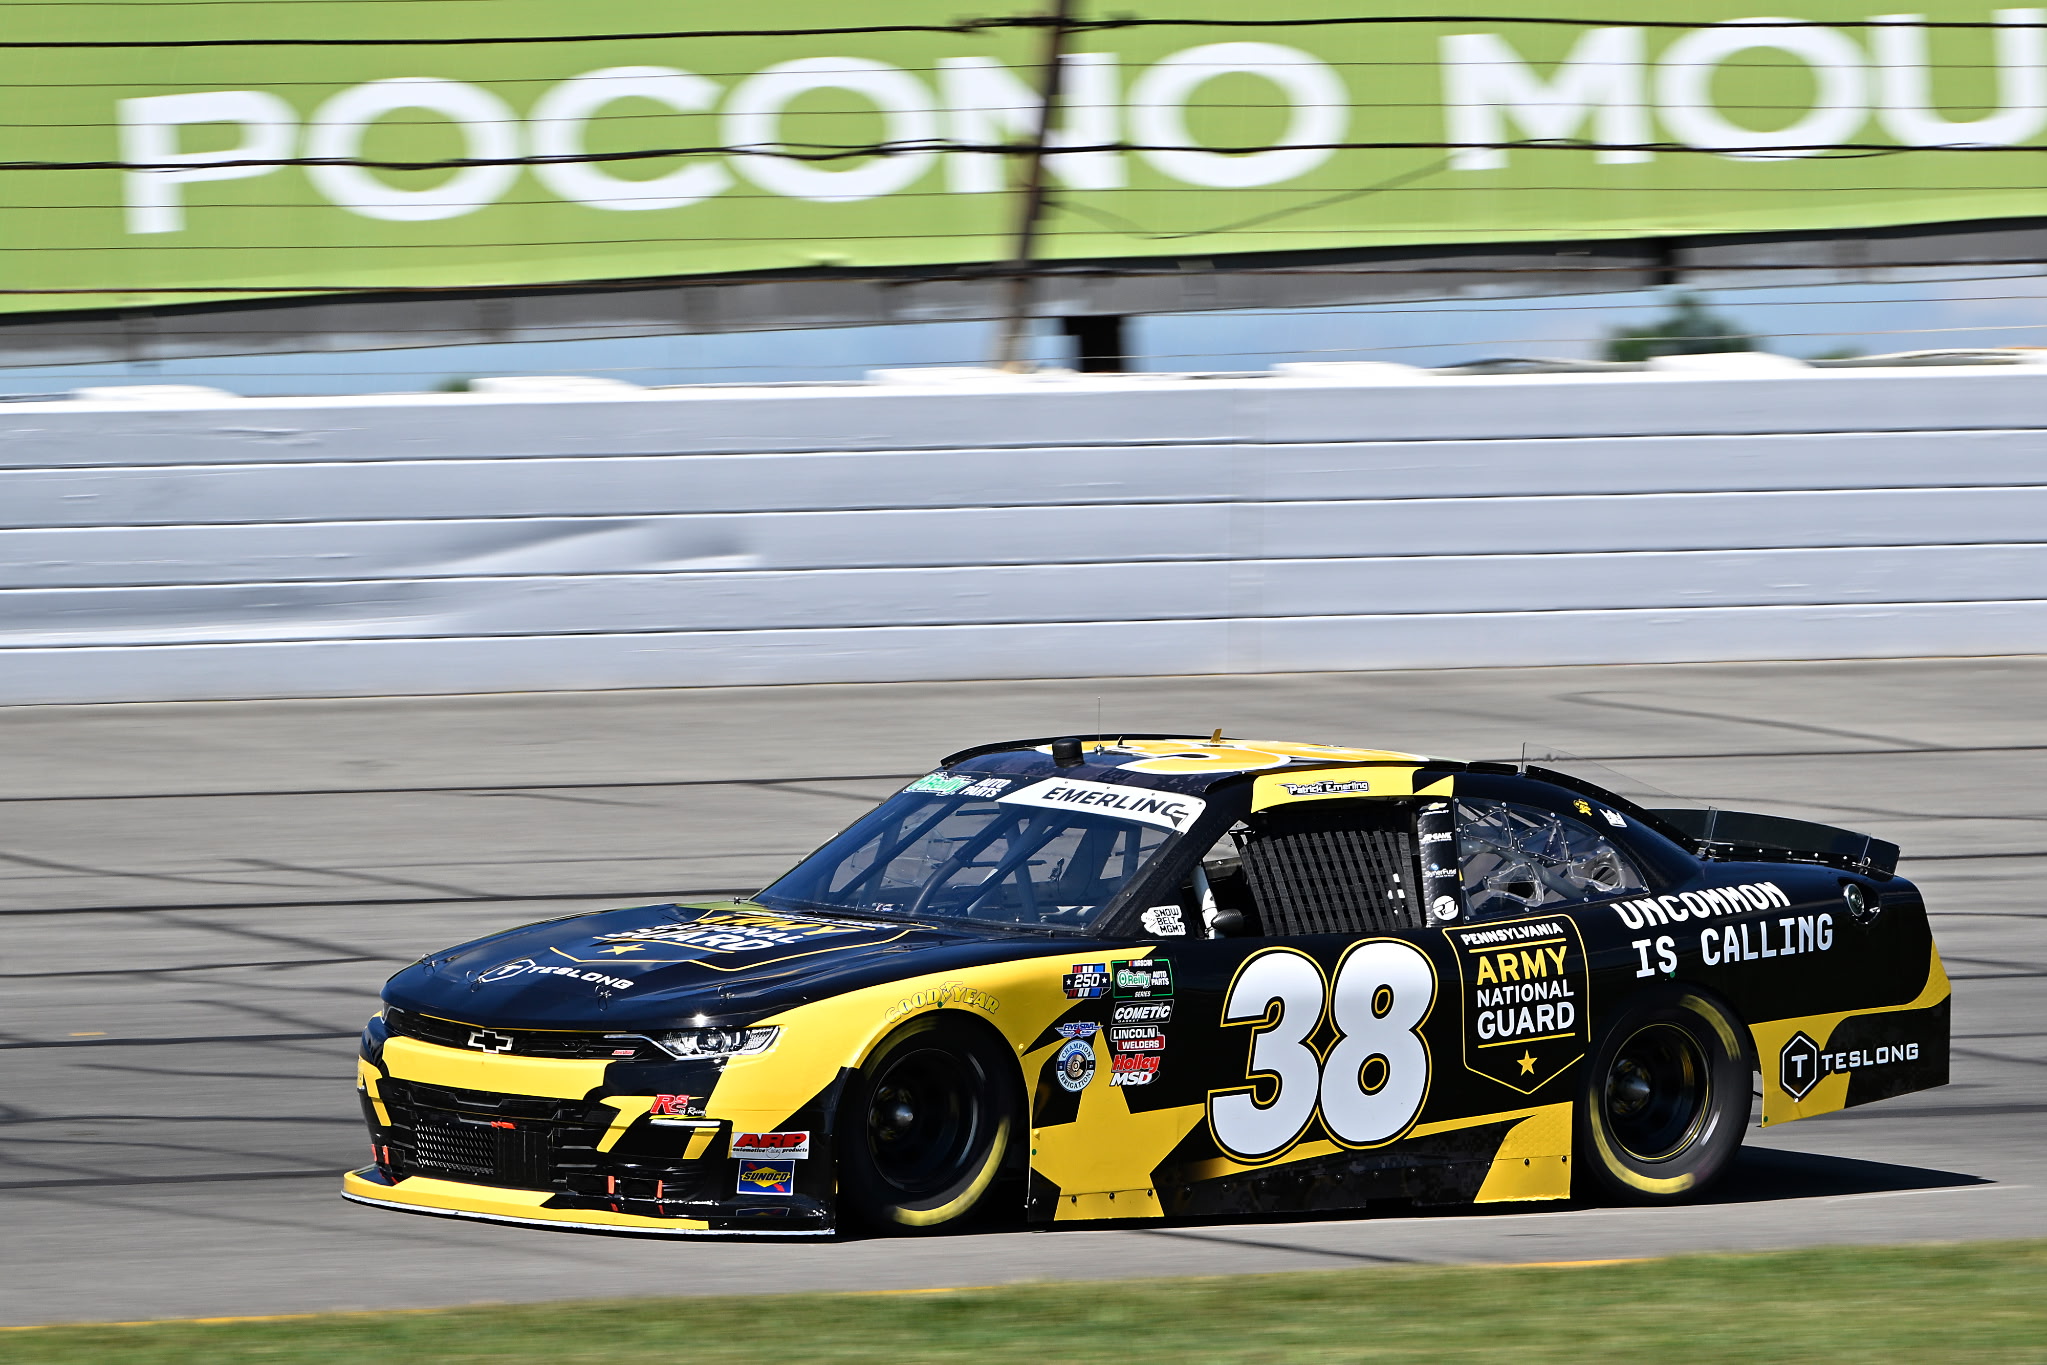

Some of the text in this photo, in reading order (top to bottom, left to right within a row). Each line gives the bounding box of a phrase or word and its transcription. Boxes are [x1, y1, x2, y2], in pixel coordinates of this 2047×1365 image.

[117, 42, 1349, 234] POCONO
[1288, 781, 1368, 795] Patrick Emerling
[1041, 786, 1189, 822] EMERLING
[1153, 908, 1180, 918] SNOW
[1610, 881, 1791, 930] UNCOMMON
[1156, 917, 1177, 925] BELT
[1160, 925, 1184, 933] MGMT
[1460, 922, 1564, 946] PENNSYLVANIA
[1632, 913, 1834, 978] IS CALLING
[1476, 945, 1568, 986] ARMY
[528, 966, 635, 990] TESLONG
[1073, 973, 1100, 988] 250
[1151, 977, 1170, 986] PARTS
[1476, 979, 1575, 1008] NATIONAL
[1114, 1005, 1171, 1020] COMETIC
[1477, 1001, 1575, 1040] GUARD
[1113, 1028, 1156, 1040] LINCOLN
[1061, 1042, 1093, 1060] CHAMPION
[1121, 1040, 1160, 1050] WELDERS
[1211, 941, 1434, 1156] 38
[1112, 1053, 1161, 1074] Holley
[1821, 1043, 1919, 1071] TESLONG
[1059, 1072, 1092, 1090] IRRIGATION
[1109, 1072, 1153, 1086] MSD
[733, 1133, 807, 1148] ARP
[743, 1172, 790, 1181] SUNOCO
